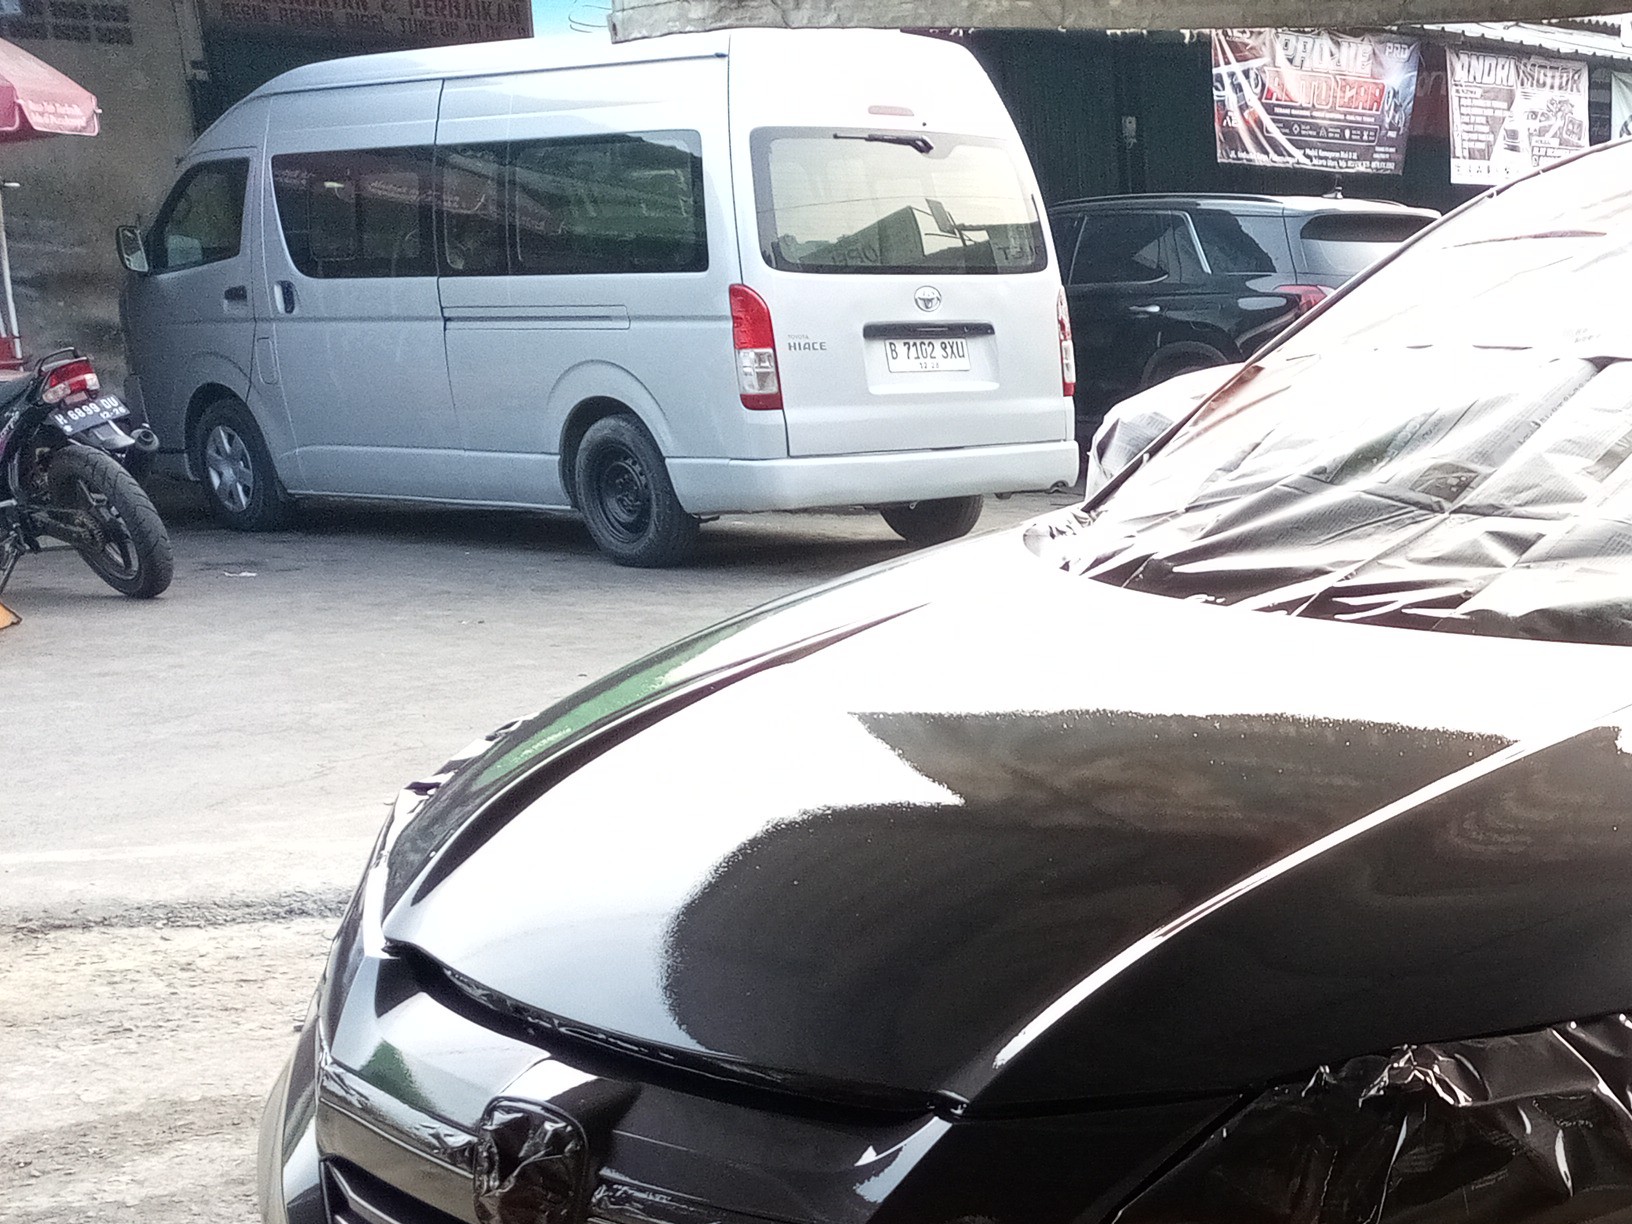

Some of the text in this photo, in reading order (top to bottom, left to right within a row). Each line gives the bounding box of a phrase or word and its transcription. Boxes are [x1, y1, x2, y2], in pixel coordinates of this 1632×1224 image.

[1452, 52, 1517, 88] ANDRI
[787, 341, 828, 351] HIACE
[889, 342, 899, 360] B
[903, 341, 935, 360] 7102
[67, 402, 101, 420] 6899
